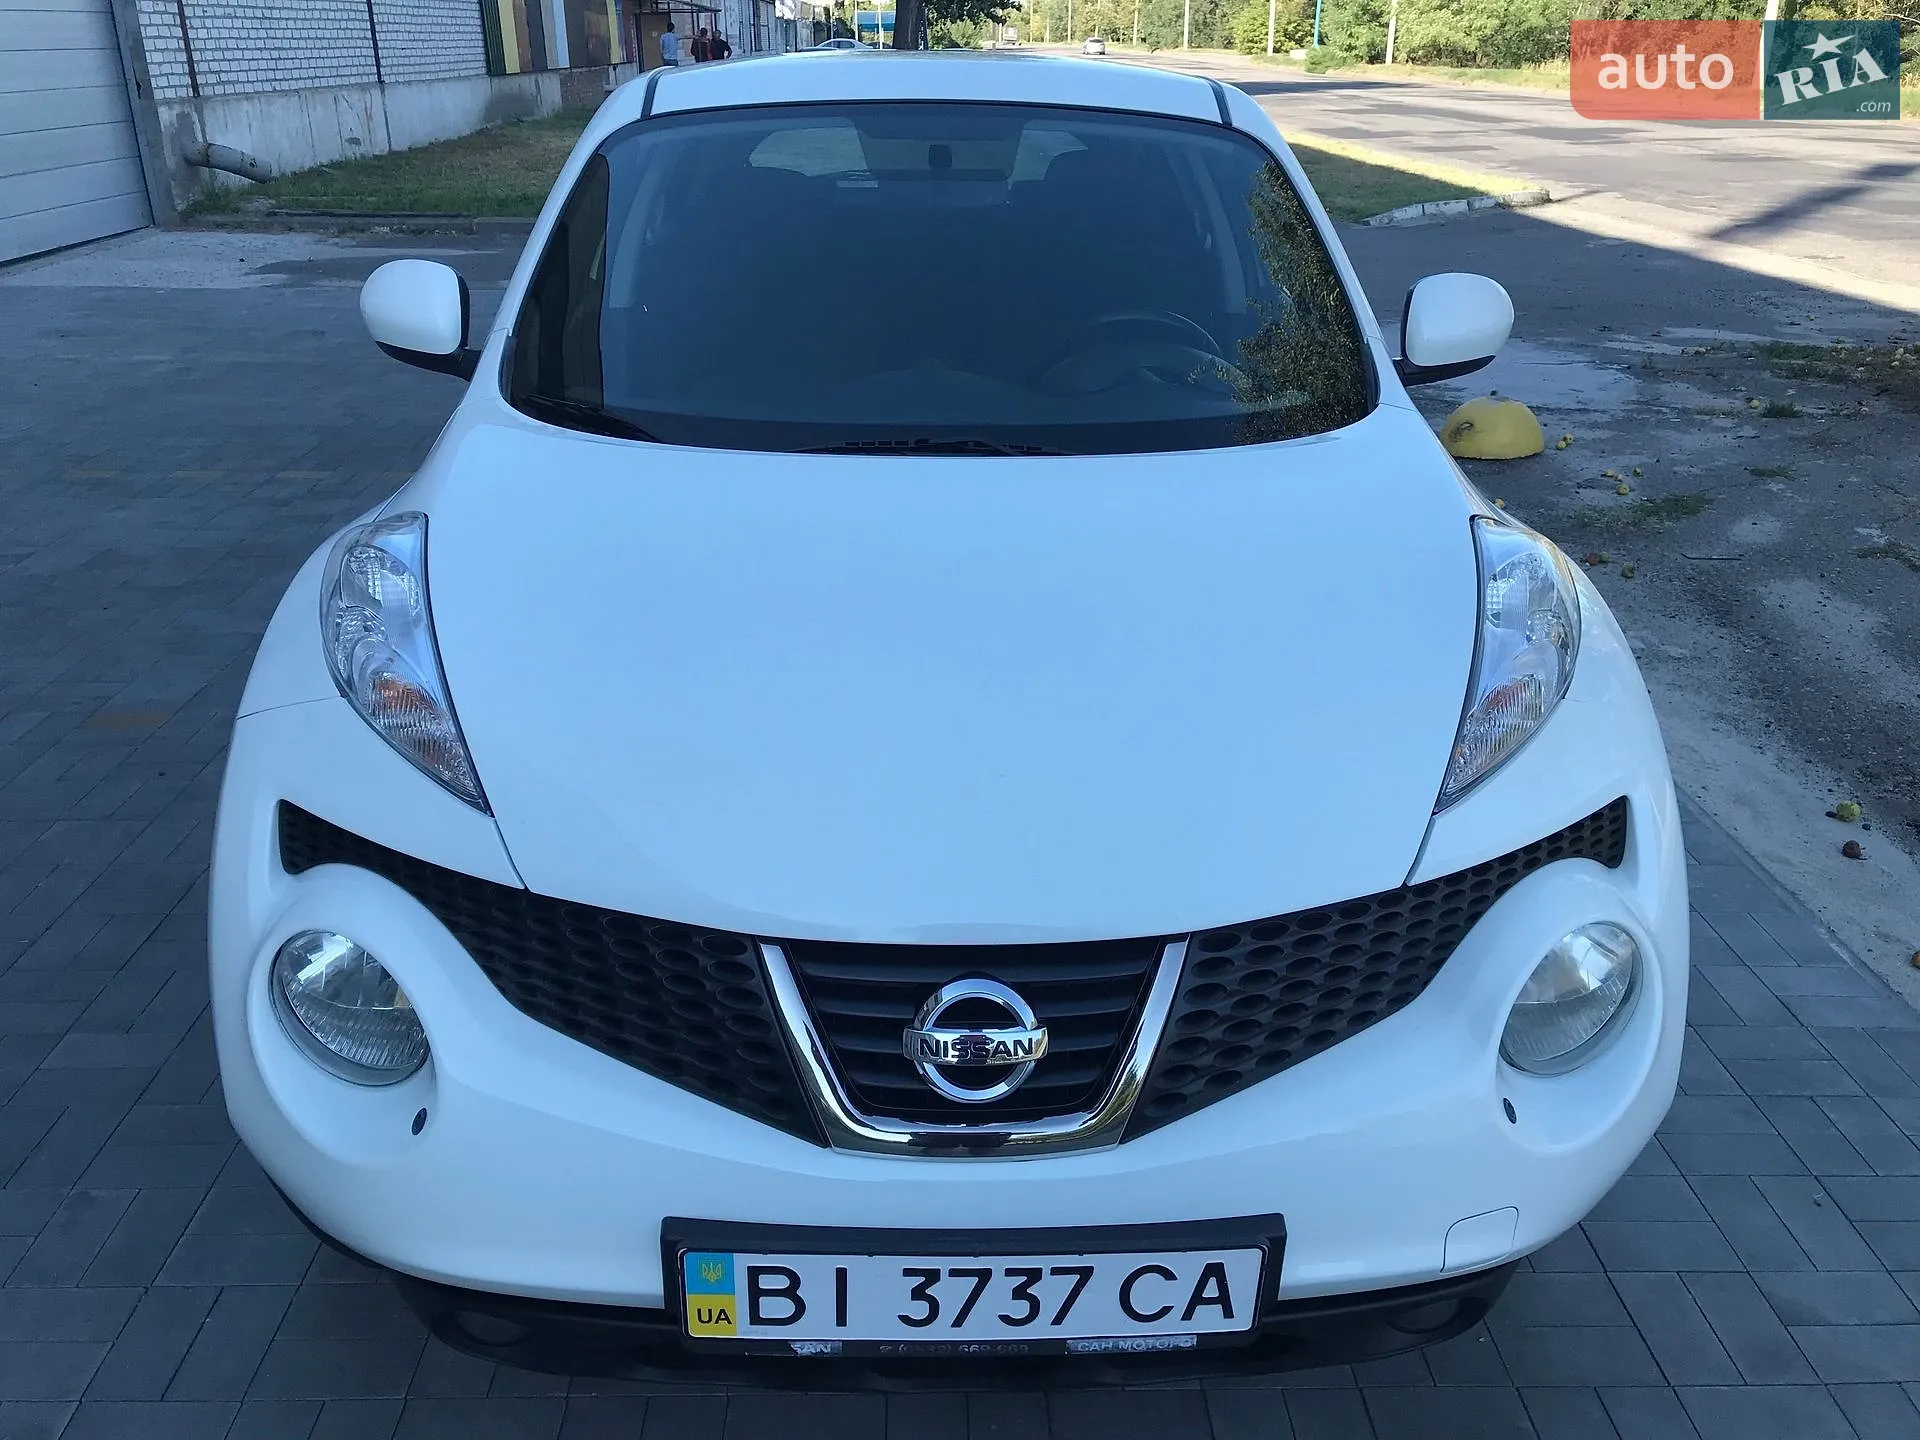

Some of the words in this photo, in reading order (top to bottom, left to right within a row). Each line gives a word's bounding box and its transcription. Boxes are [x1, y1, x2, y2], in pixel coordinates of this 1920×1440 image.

[918, 1036, 1033, 1060] NISSAN
[746, 1264, 848, 1328] BI
[897, 1265, 1095, 1328] 3737
[1118, 1261, 1235, 1324] CA
[696, 1307, 733, 1325] UA
